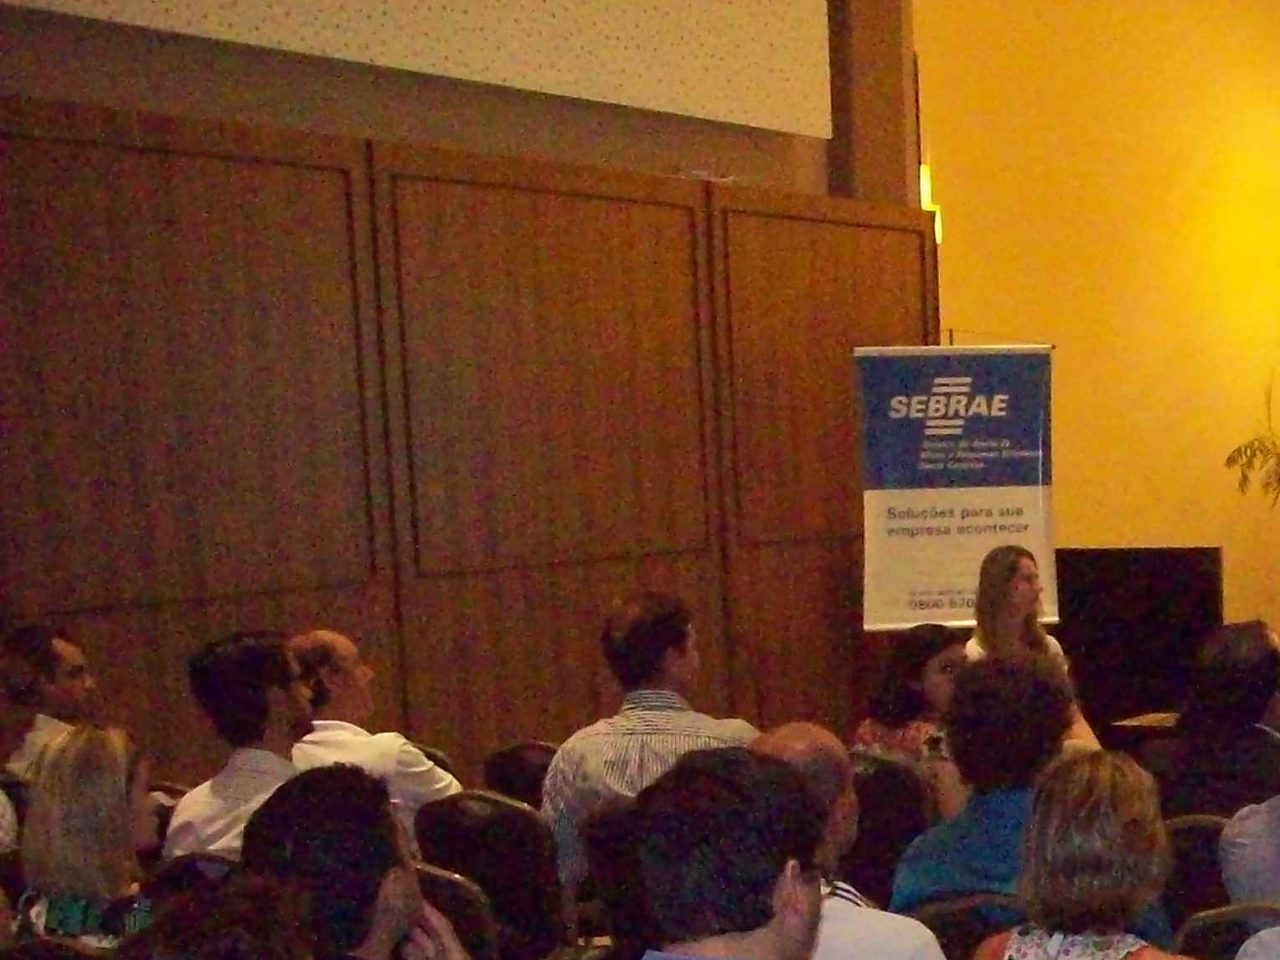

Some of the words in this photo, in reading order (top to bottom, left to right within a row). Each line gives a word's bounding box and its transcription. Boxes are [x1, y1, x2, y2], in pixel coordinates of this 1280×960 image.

[889, 394, 1010, 419] SEBRAE
[886, 506, 955, 521] Soluções
[960, 507, 994, 520] para
[998, 506, 1024, 518] sua
[886, 524, 952, 538] empresa
[957, 522, 1030, 535] acontecer
